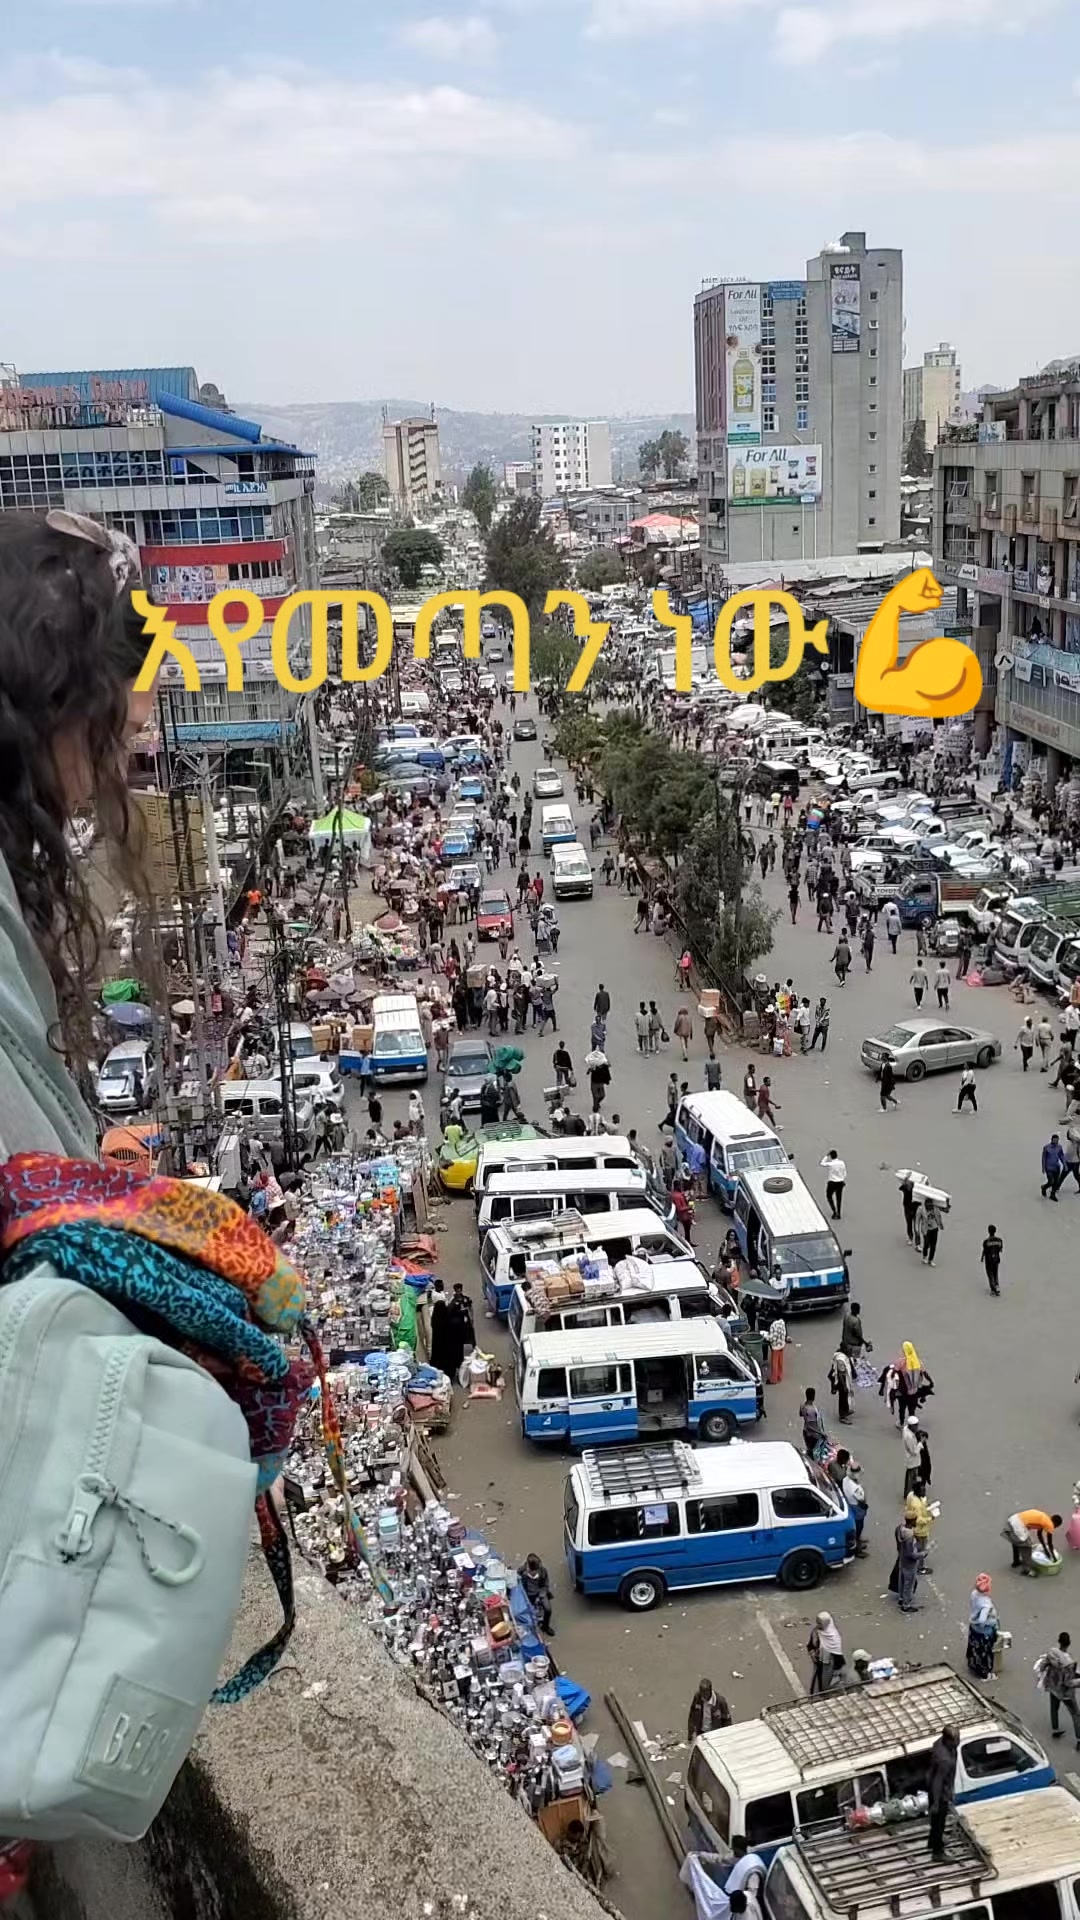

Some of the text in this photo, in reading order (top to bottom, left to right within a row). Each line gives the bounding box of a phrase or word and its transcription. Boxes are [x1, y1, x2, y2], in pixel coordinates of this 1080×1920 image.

[728, 289, 743, 300] For
[744, 288, 757, 299] All
[745, 447, 788, 463] For All
